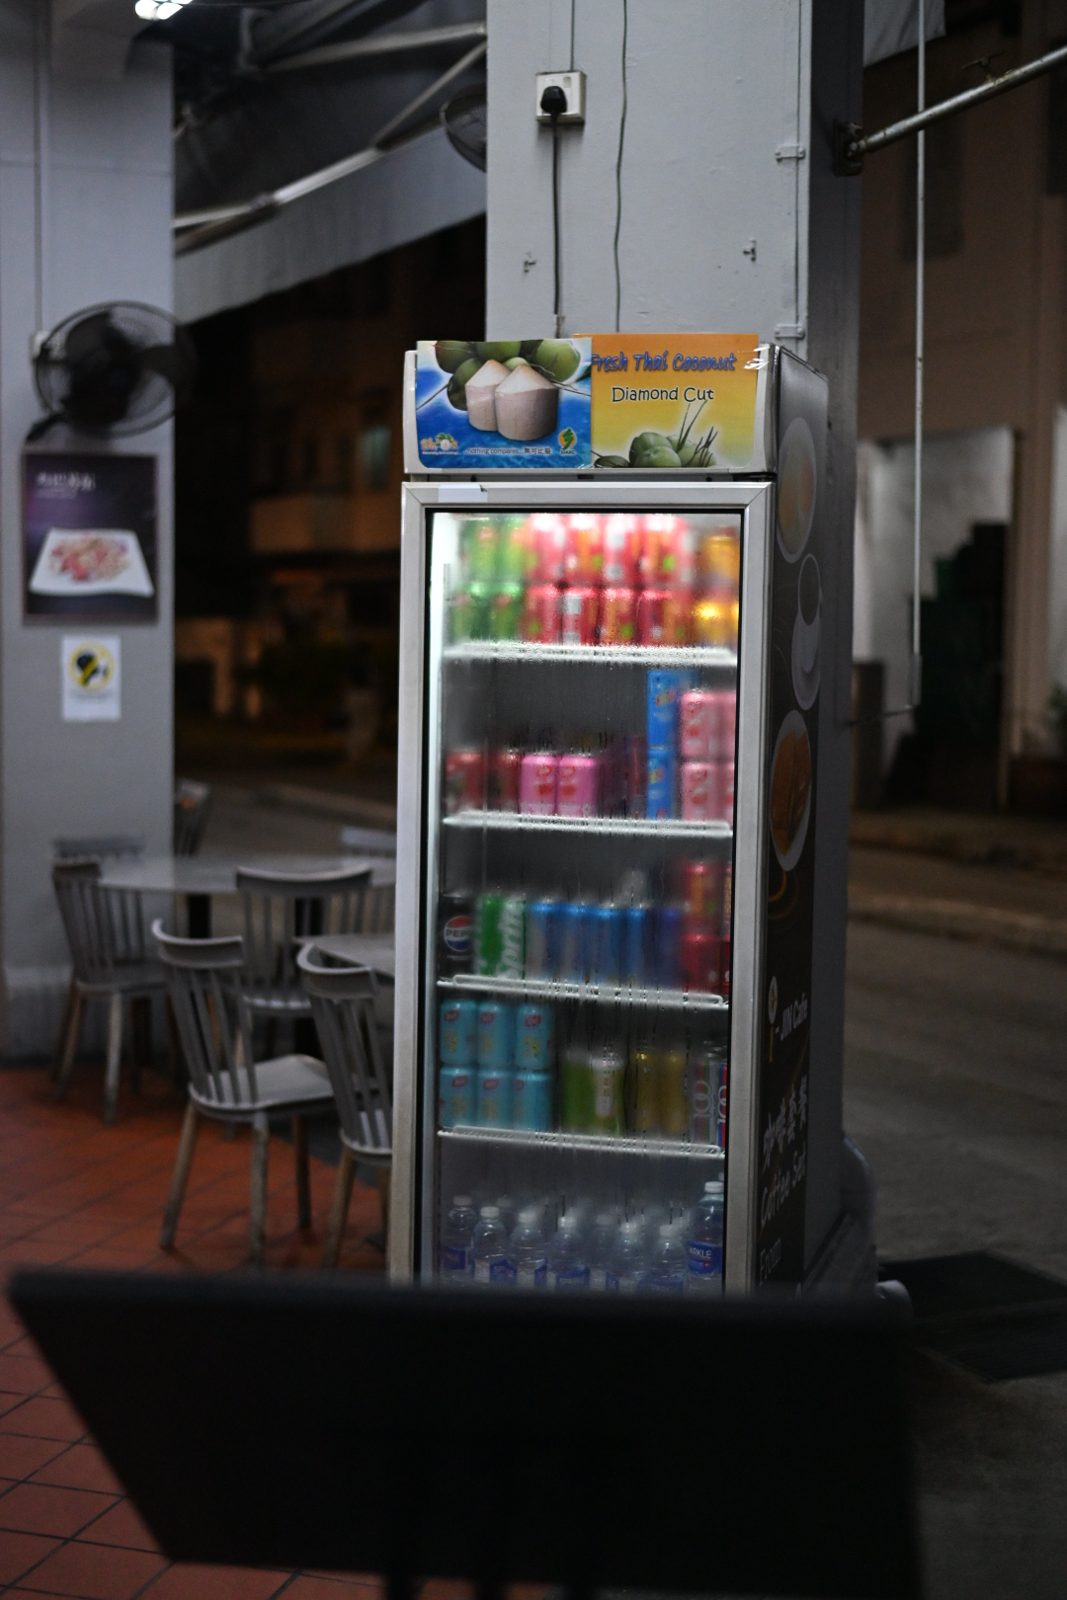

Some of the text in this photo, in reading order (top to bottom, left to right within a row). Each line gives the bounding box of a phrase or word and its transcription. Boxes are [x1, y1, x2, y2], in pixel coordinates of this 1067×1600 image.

[591, 350, 737, 372] Fresh Thai Coconut
[612, 387, 714, 403] Diamond Cut
